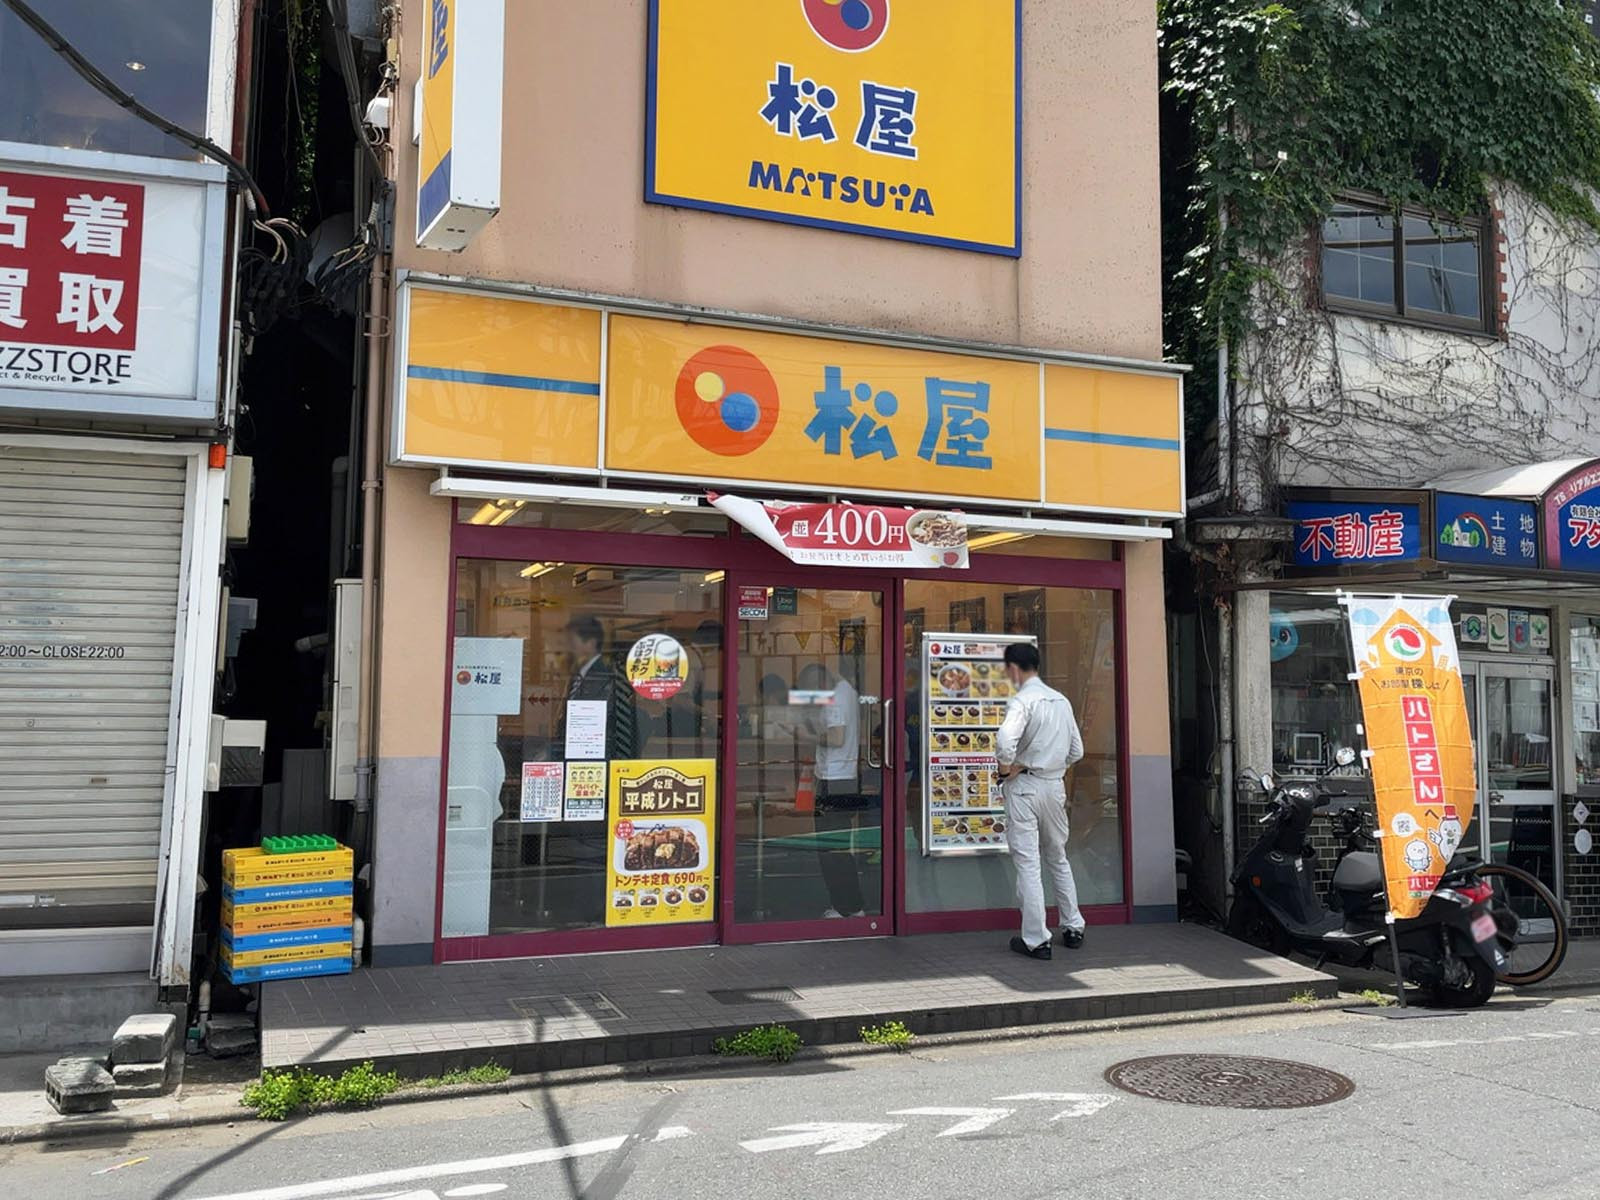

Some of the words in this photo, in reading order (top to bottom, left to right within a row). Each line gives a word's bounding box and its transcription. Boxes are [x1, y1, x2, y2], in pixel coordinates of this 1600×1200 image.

[760, 62, 918, 161] 松屋
[749, 161, 936, 217] MATSUYA
[0, 346, 132, 378] ZSTORE
[24, 372, 67, 382] Recycle
[804, 366, 993, 470] 松屋
[814, 508, 904, 546] 400円
[1491, 511, 1535, 534] 土地
[1300, 509, 1405, 561] 不動産
[1491, 536, 1536, 559] 建物
[943, 644, 961, 655] 松屋
[474, 672, 502, 685] 松屋
[1407, 700, 1439, 799] ハトさん
[653, 779, 673, 790] 松屋
[624, 791, 699, 811] 平成レトロ
[615, 873, 670, 887] トンテキ定食
